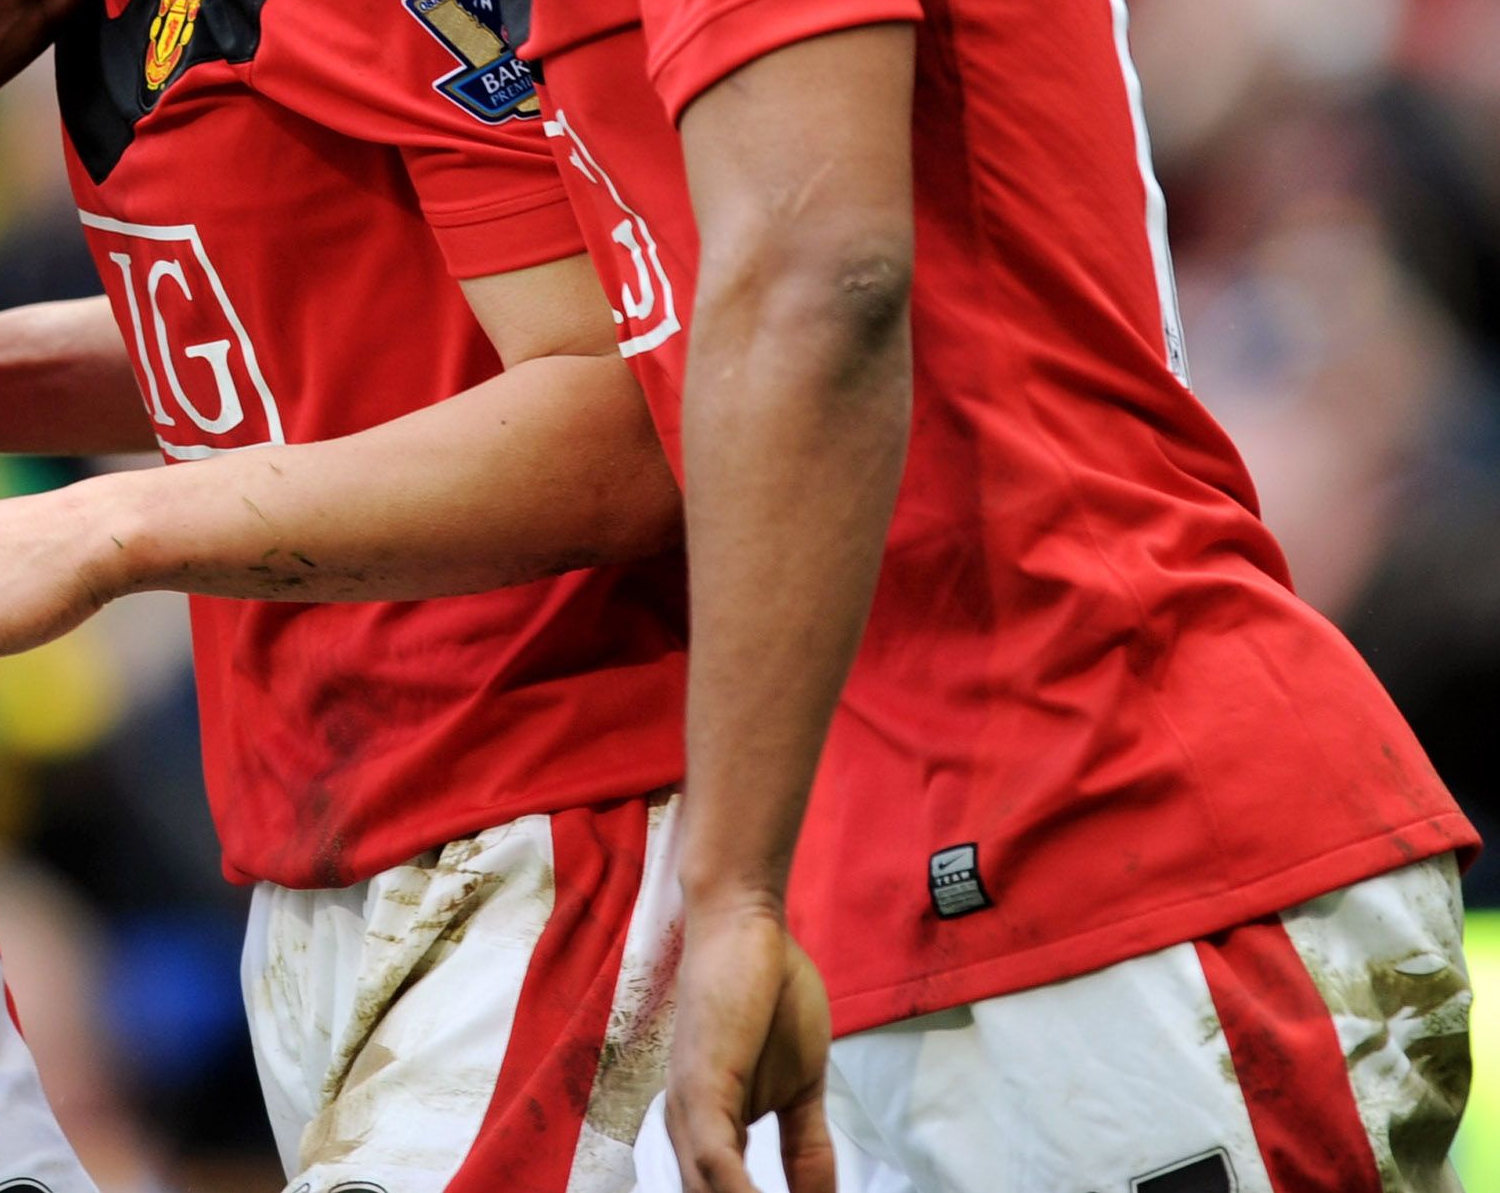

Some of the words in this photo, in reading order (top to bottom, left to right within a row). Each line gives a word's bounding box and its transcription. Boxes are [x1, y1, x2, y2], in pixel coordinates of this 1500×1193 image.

[481, 58, 531, 94] BAR
[490, 74, 533, 107] PREMI
[109, 252, 244, 434] IG
